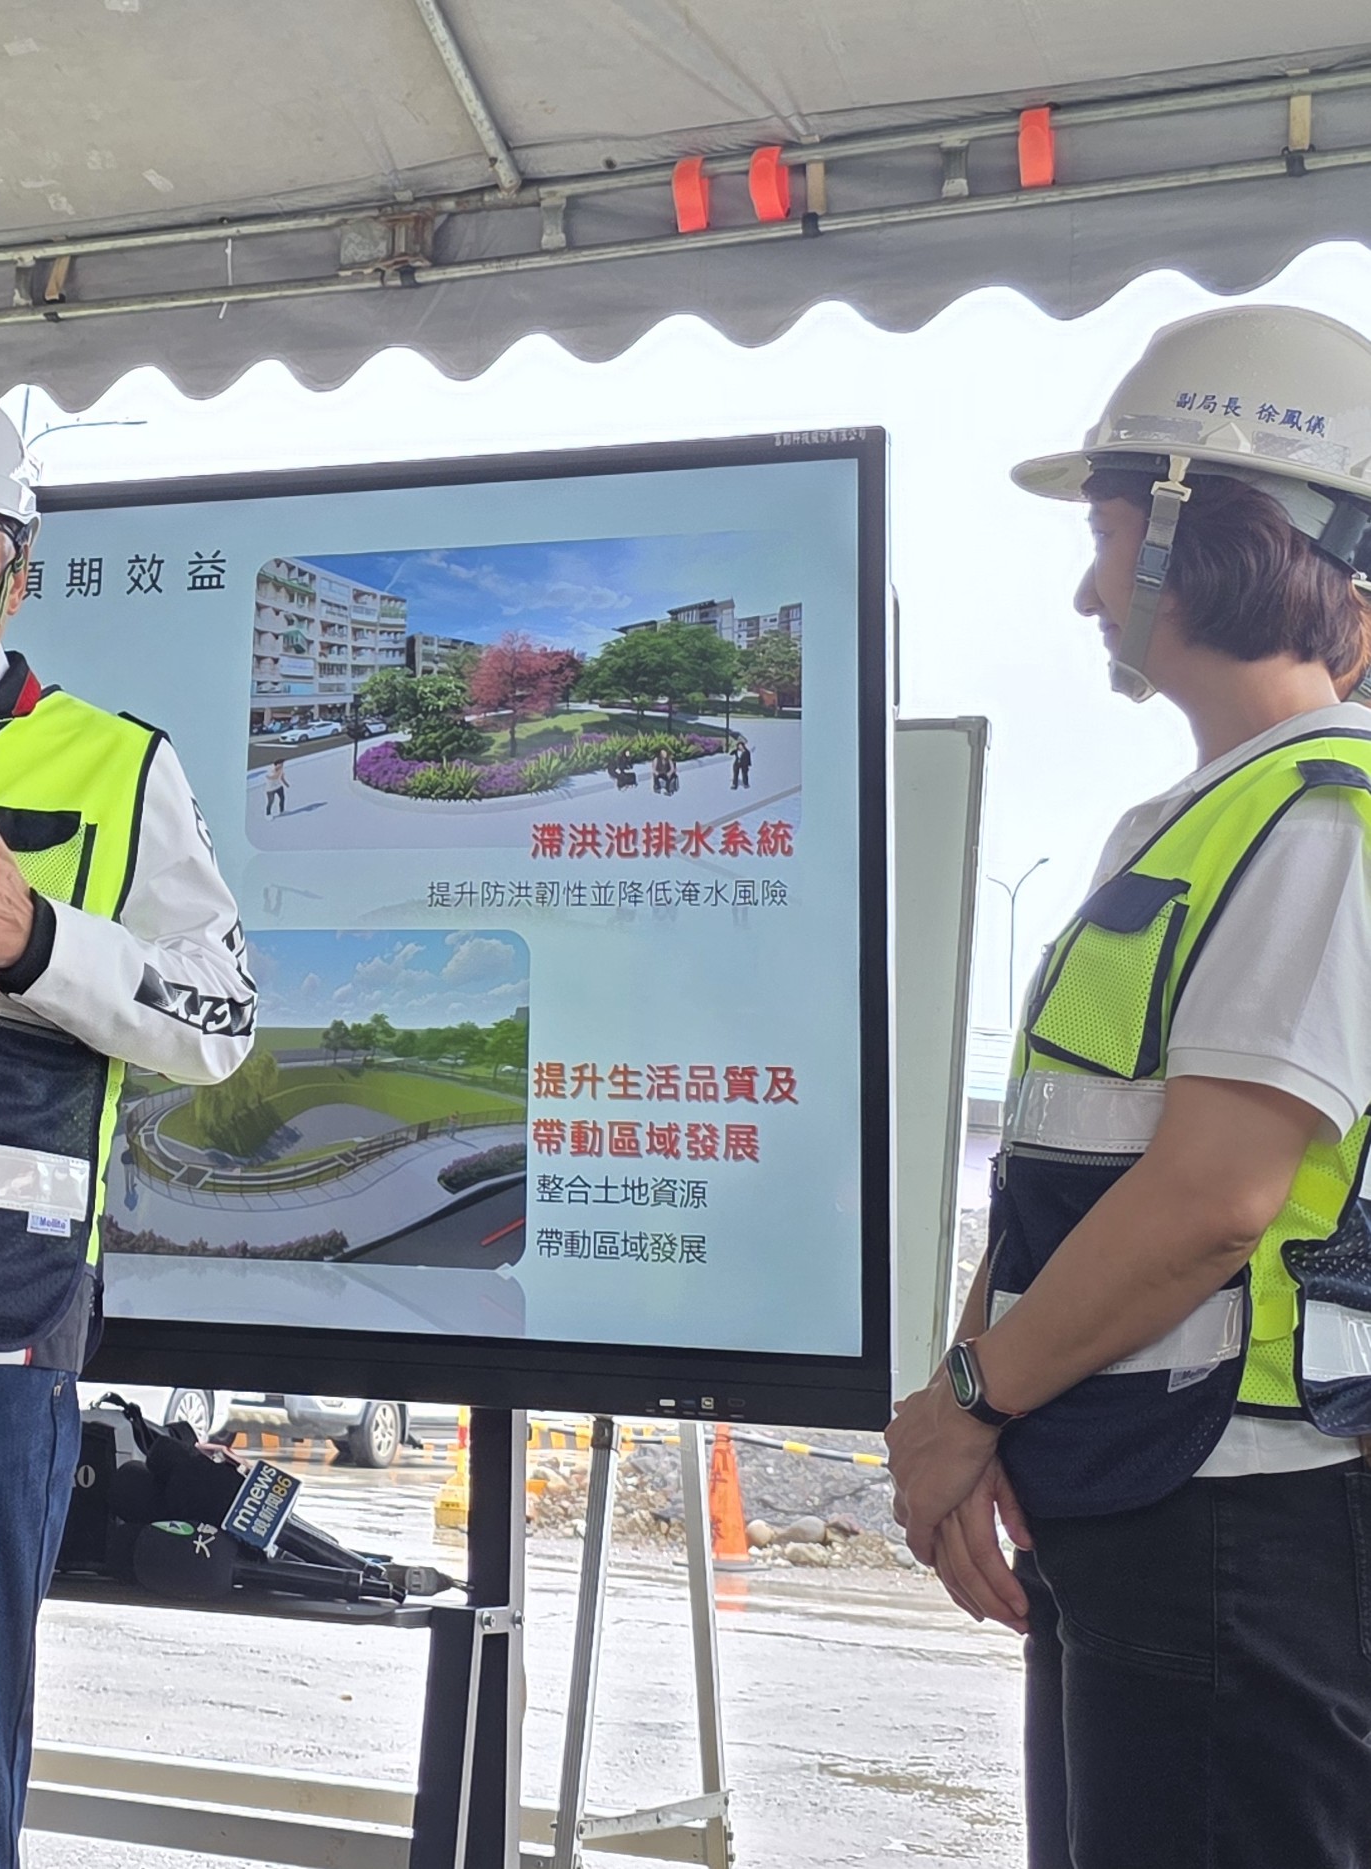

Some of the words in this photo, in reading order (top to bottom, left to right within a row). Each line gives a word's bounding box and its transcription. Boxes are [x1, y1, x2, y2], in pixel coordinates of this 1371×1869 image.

[1176, 393, 1242, 417] 副局長
[1256, 403, 1326, 438] 徐鳳儀
[531, 820, 795, 859] 滯洪池排水系統
[427, 880, 789, 908] 提升防洪韌性並降低淹水風險
[533, 1061, 799, 1104] 提升生活品質及
[532, 1118, 760, 1163] 帶動區域發展
[536, 1174, 708, 1209] 整合土地資源
[536, 1227, 707, 1264] 帶動區域發展
[233, 1465, 277, 1531] mnews
